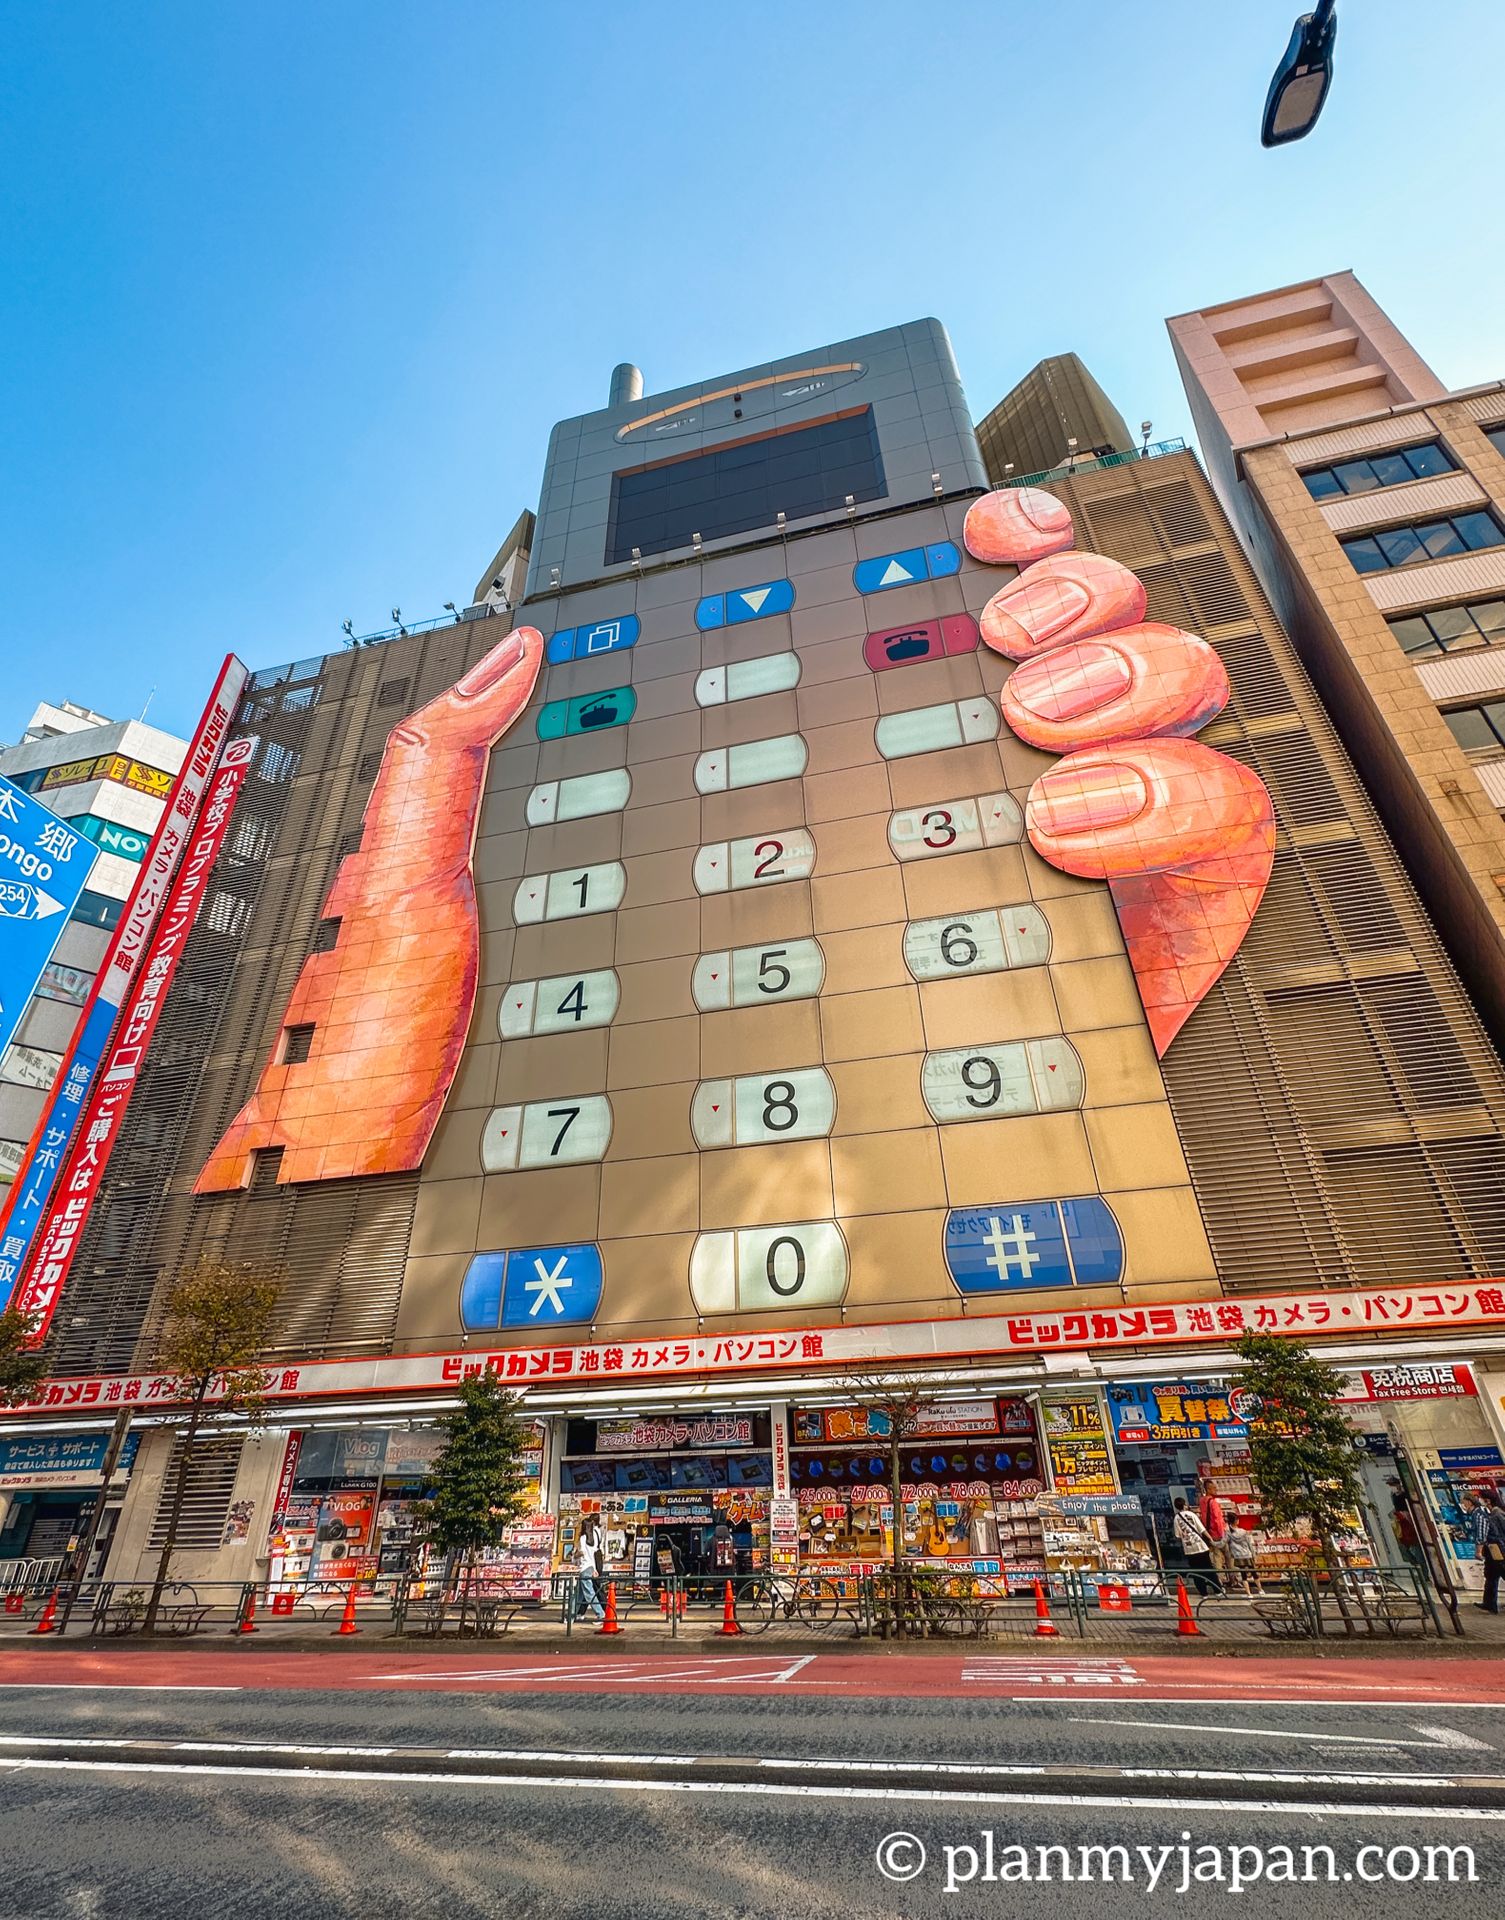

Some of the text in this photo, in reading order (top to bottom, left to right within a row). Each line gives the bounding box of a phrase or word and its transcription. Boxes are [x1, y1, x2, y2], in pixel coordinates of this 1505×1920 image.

[176, 784, 197, 820] 池袋
[921, 810, 957, 849] 3
[754, 840, 785, 879] 2
[123, 769, 239, 1045] 小学校プログラミング教育向け
[572, 873, 589, 908] 1
[940, 923, 978, 967] 6
[757, 950, 791, 994] 5
[557, 980, 589, 1021] 4
[101, 1082, 131, 1094] パソコン
[961, 1055, 1002, 1109] 9
[762, 1080, 799, 1131] 8
[547, 1107, 580, 1156] 7
[766, 1236, 806, 1296] 0
[1007, 1288, 1505, 1344] ビックカメラ 池袋 カメラ・パソコン館
[442, 1334, 823, 1382] ビックカメラ 池袋 カメラ・パソコン館
[1371, 1365, 1456, 1388] 免税商店
[104, 1380, 142, 1401] 池袋
[1372, 1386, 1437, 1398] Tax Free Store
[9, 1441, 100, 1458] サービス サポート
[333, 1501, 361, 1512] VLOG
[667, 1496, 703, 1504] GALLERIA
[1062, 1499, 1087, 1511] Enjoy
[1093, 1502, 1107, 1512] the
